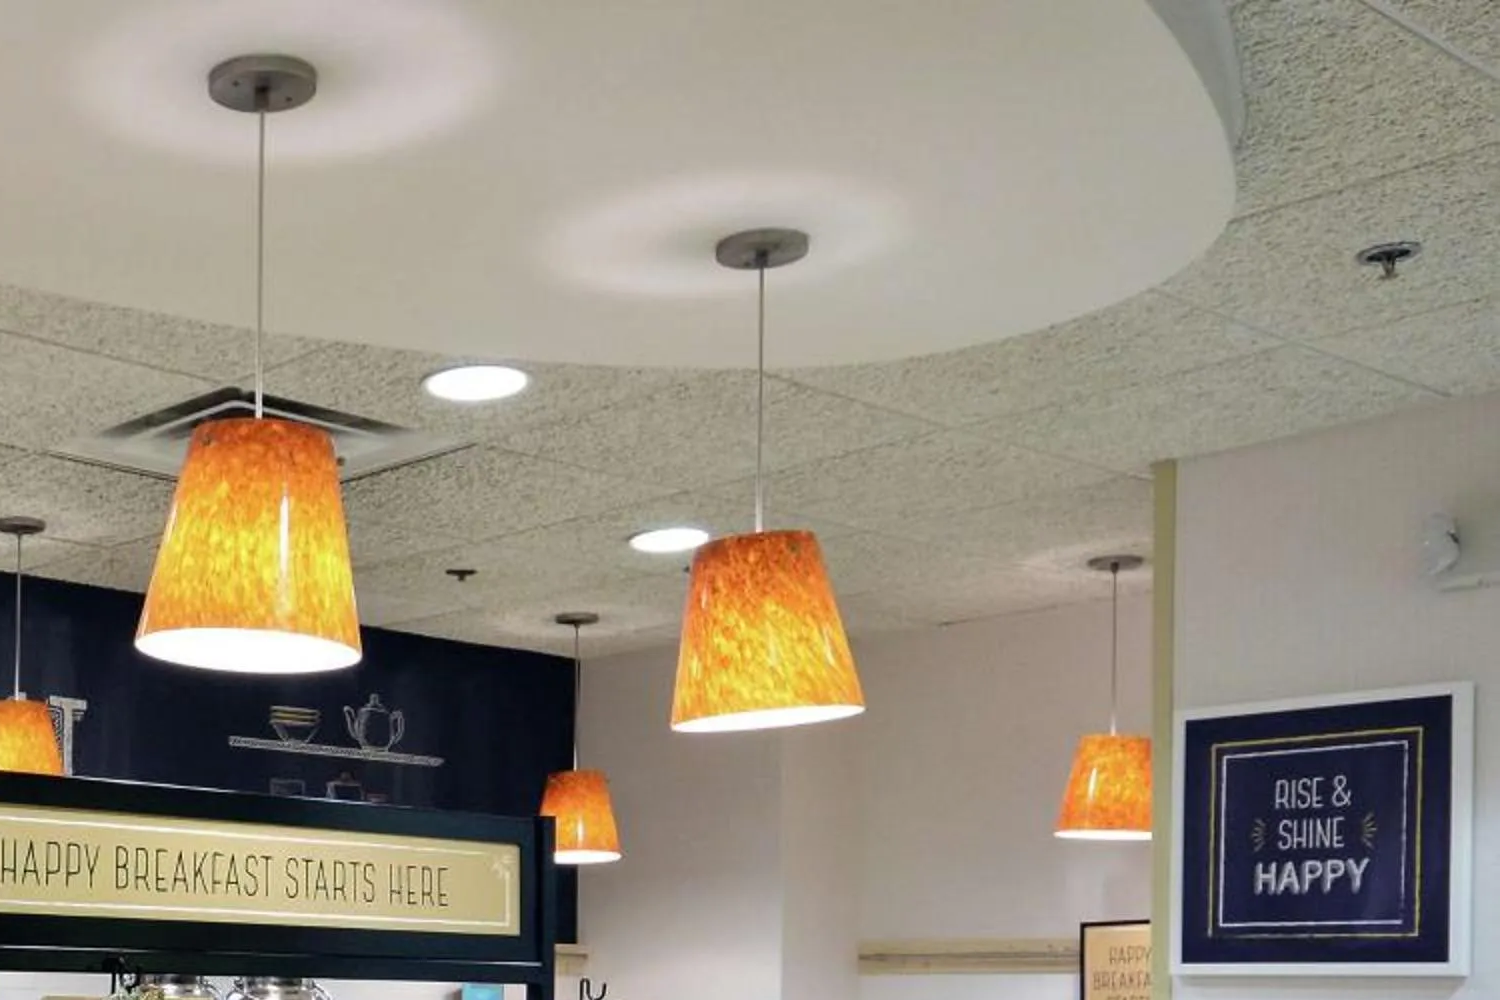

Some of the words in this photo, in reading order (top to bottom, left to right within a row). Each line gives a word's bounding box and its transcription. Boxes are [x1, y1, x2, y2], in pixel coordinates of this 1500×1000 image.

[1274, 777, 1325, 809] RISE
[1331, 775, 1352, 807] &
[1277, 816, 1345, 850] SHINE
[0, 838, 101, 889] HAPPY
[115, 845, 274, 898] BREAKFAST
[285, 856, 376, 904] STARTS
[389, 863, 449, 907] HERE
[1254, 857, 1370, 895] HAPPY
[1093, 970, 1151, 991] BREAKFA
